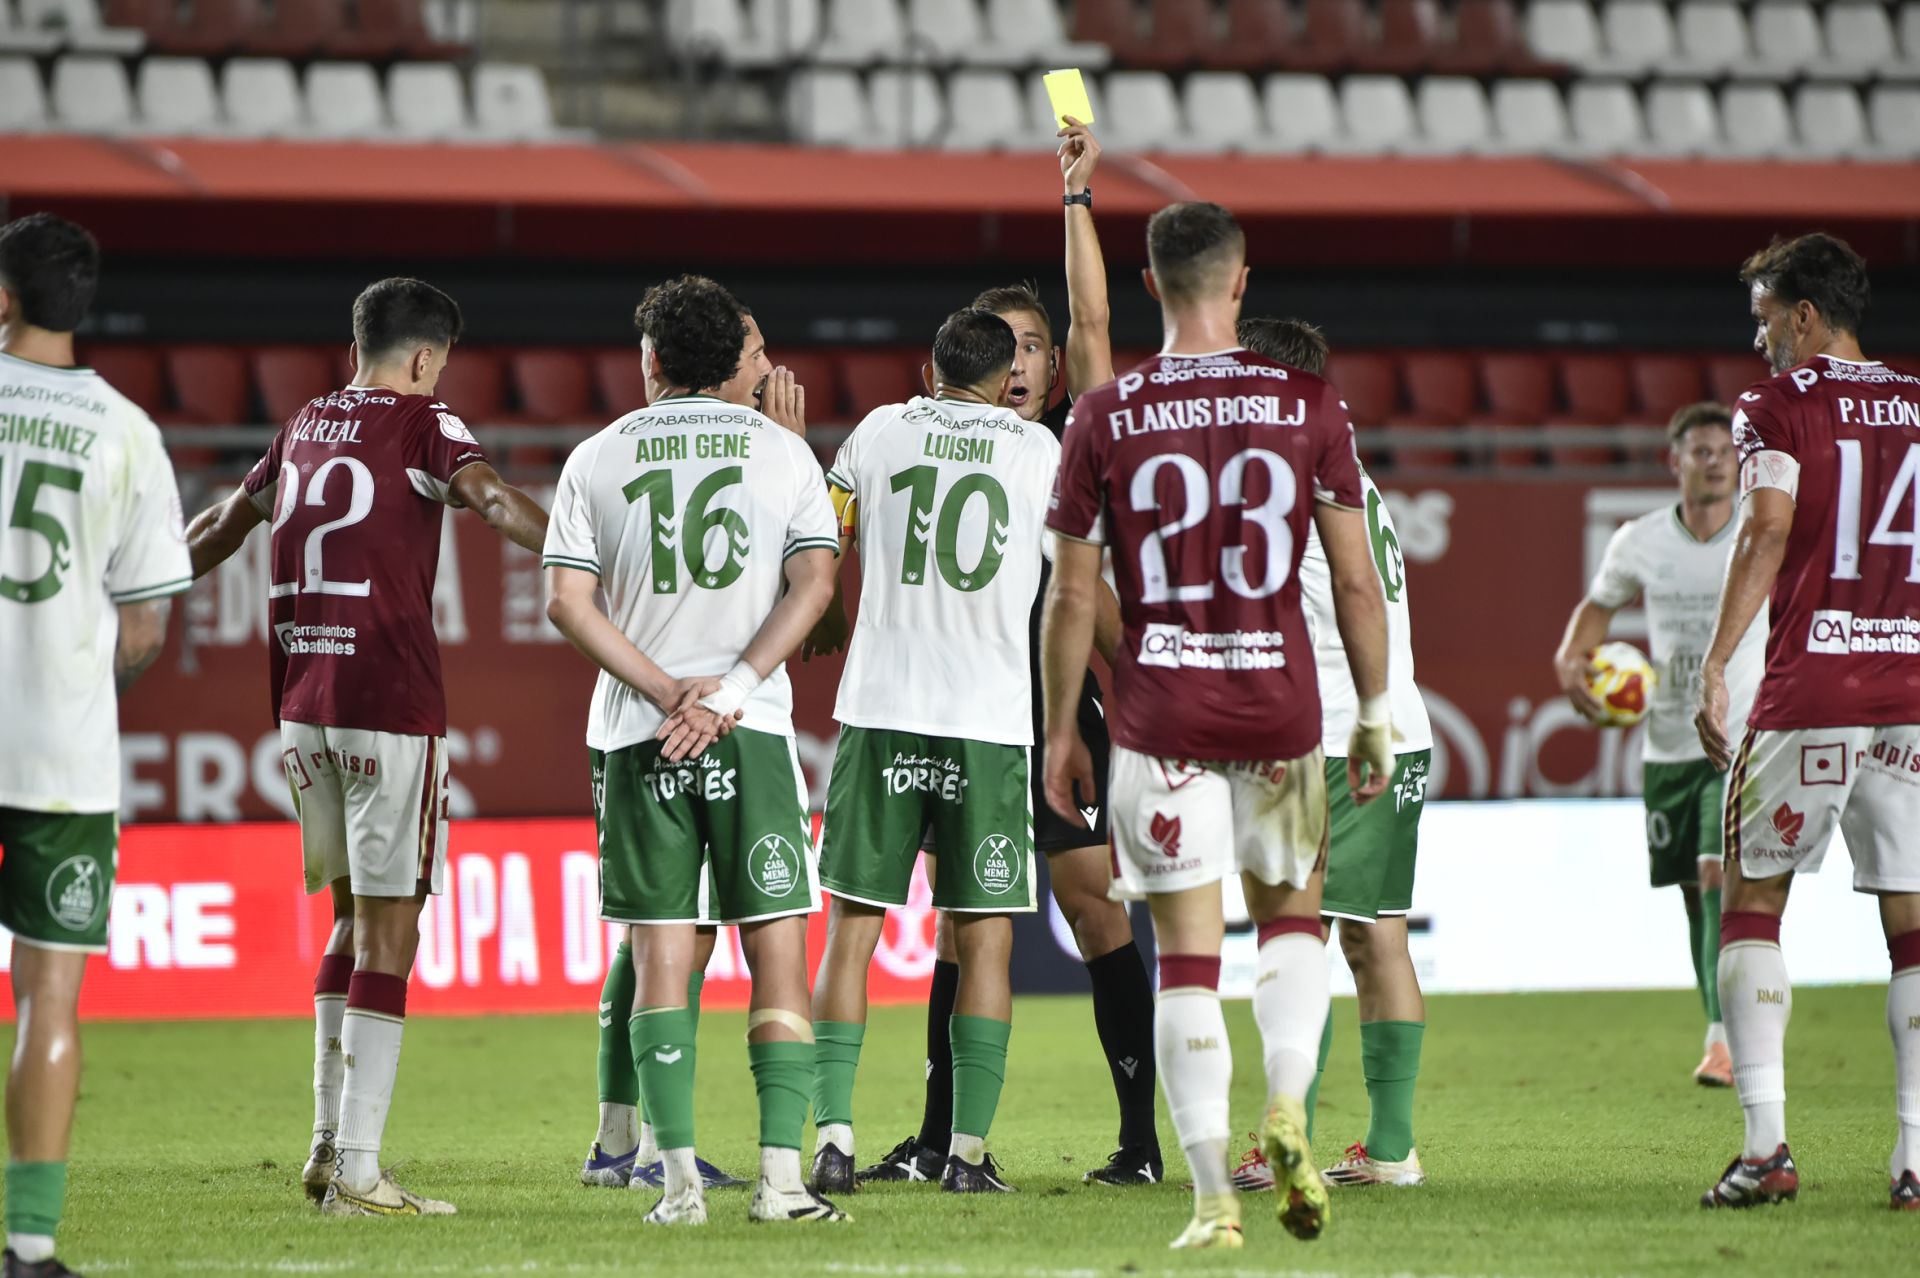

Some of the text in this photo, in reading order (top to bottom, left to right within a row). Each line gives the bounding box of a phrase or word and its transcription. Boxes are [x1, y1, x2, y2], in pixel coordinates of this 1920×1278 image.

[1150, 365, 1288, 385] aparcamurcia
[0, 384, 107, 416] BASTHOSUR
[655, 414, 764, 429] ABASTHOSUR
[933, 415, 1024, 436] ABASTHOSUR
[1108, 395, 1307, 441] FLAKUS BOSILJ
[635, 431, 751, 463] ADRI GENÉ
[923, 432, 995, 464] LUISMI
[1130, 448, 1297, 604] 23
[1829, 439, 1920, 583] 14
[0, 455, 84, 603] 5
[622, 465, 750, 594] 16
[890, 465, 1010, 592] 10
[290, 638, 356, 655] abatibles
[1180, 647, 1287, 670] abatibles
[882, 767, 969, 804] TORRES
[764, 859, 786, 871] CASA
[986, 858, 1008, 868] CASA
[107, 882, 237, 970] RE
[1757, 989, 1785, 1005] RMU
